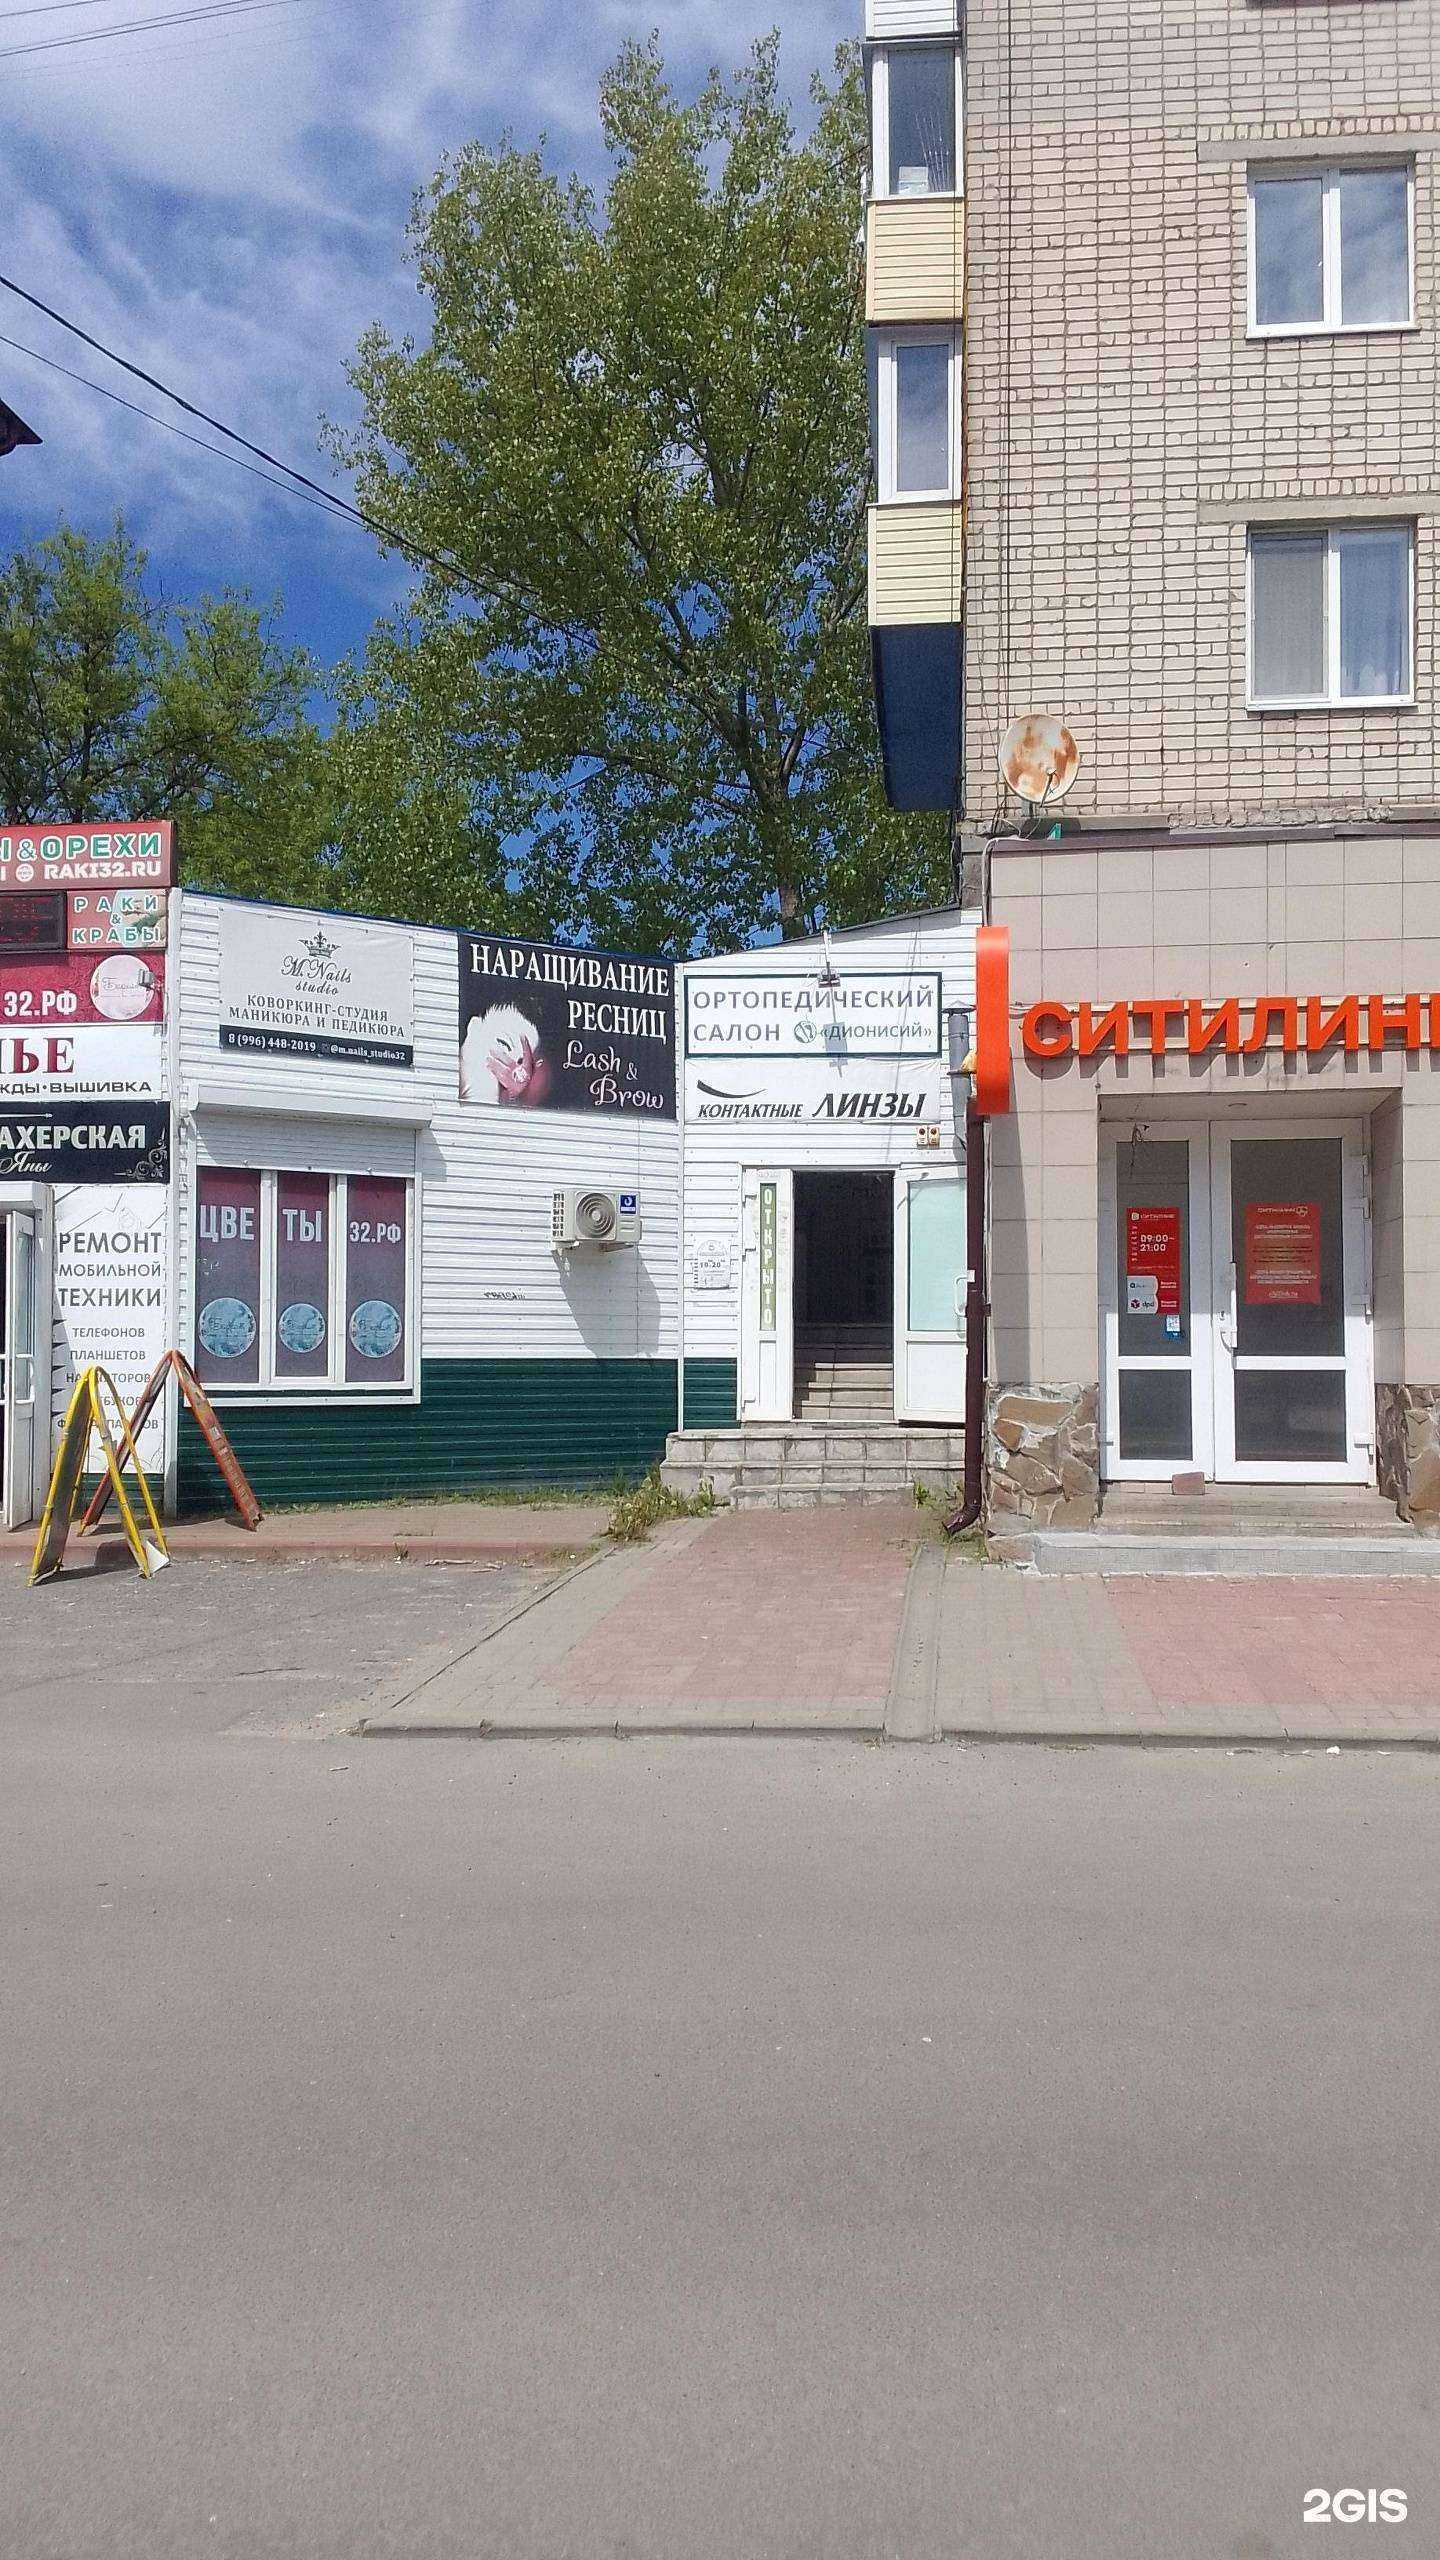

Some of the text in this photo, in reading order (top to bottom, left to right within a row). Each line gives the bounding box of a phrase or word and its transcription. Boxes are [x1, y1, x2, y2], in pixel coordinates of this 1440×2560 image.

[40, 832, 162, 861] ОРЕХИ
[43, 861, 162, 880] RAKI32.RU
[74, 895, 159, 913] РАКИ
[72, 927, 161, 944] КРАБЫ
[470, 943, 670, 997] НАРАЩИВАНИЕ
[295, 980, 339, 996] studio
[693, 985, 932, 1012] ОРТОПЕДИЧЕСКИЙ
[4, 990, 77, 1017] 32.РФ
[247, 994, 388, 1022] КОВОРКИНГ-СТУДИЯ
[229, 1006, 405, 1038] МАНИКЮРА И ПЕДИКЮРА
[567, 1000, 667, 1045] РЕСНИЦ
[693, 1024, 780, 1042] САЛОН
[228, 1033, 235, 1043] 8
[237, 1034, 266, 1049] (996)
[268, 1036, 316, 1051] 448-2019
[562, 1040, 638, 1081] Lash &
[50, 1081, 152, 1093] ВЫШИВКА
[589, 1074, 664, 1109] Brow
[698, 1093, 927, 1118] КОНТАКТНЫЕ ЛИНЗЫ
[0, 1151, 53, 1174] Яны
[200, 1204, 401, 1243] ЦВЕ ТЫ 32.РФ
[59, 1232, 162, 1254] РЕМОНТ
[762, 1188, 774, 1324] ОТКРЫТО
[58, 1261, 161, 1277] МОБИЛЬНОЙ
[58, 1288, 161, 1307] ТЕХНИКИ
[72, 1327, 145, 1338] ТЕЛЕФОНОВ
[70, 1350, 146, 1360] ПЛАНШЕТОВ
